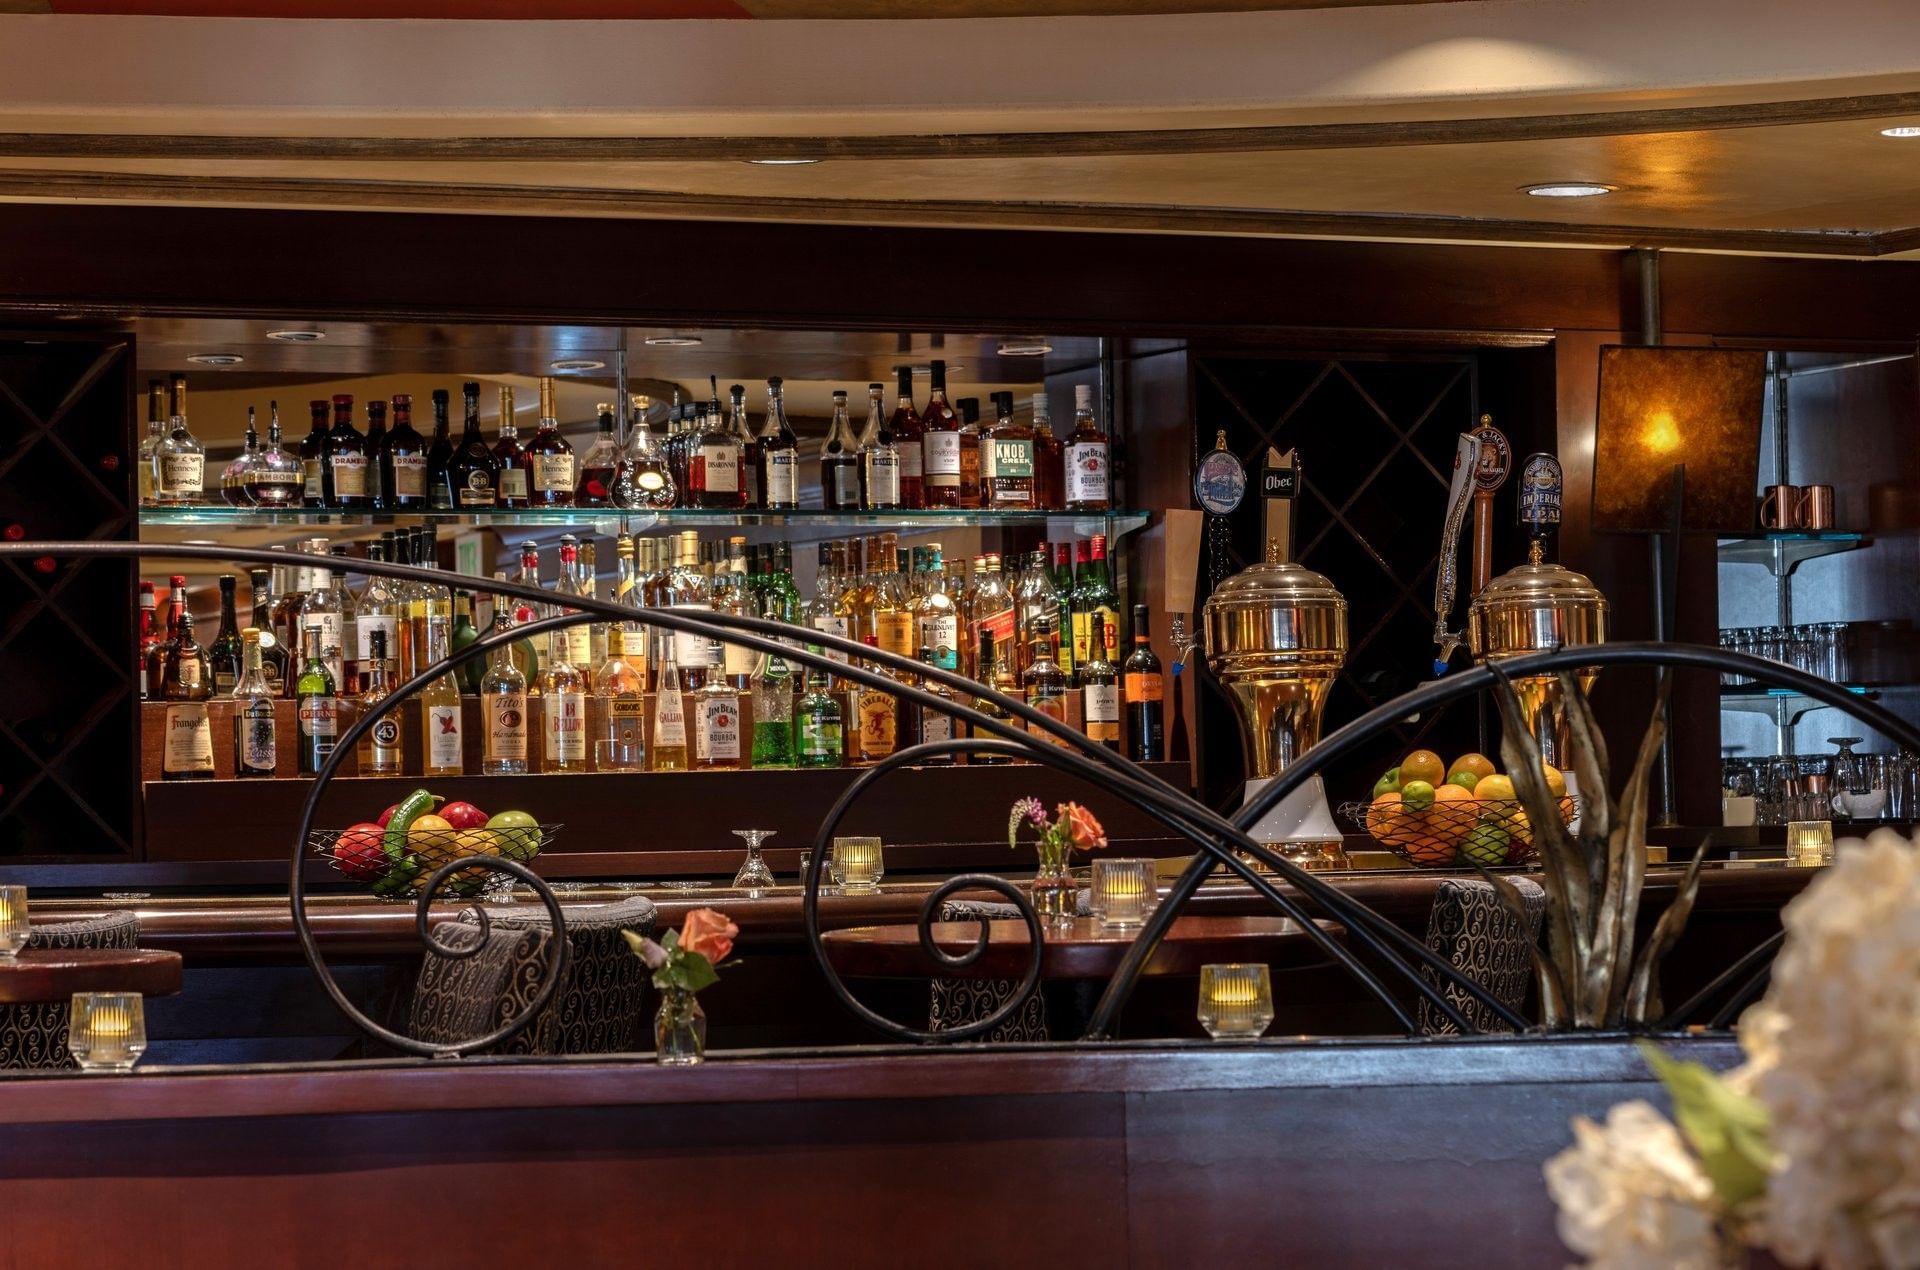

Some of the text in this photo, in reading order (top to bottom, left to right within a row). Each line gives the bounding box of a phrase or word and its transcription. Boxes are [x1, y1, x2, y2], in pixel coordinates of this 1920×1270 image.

[996, 444, 1025, 459] KNOB
[1077, 450, 1090, 463] JIM
[874, 458, 897, 466] MARTEL
[938, 631, 947, 639] 12
[495, 697, 523, 708] Tito's
[302, 710, 337, 719] PERNO
[660, 711, 683, 724] GALLIAN
[707, 706, 720, 719] JIM
[378, 725, 395, 739] 43
[709, 733, 737, 742] BOURBON
